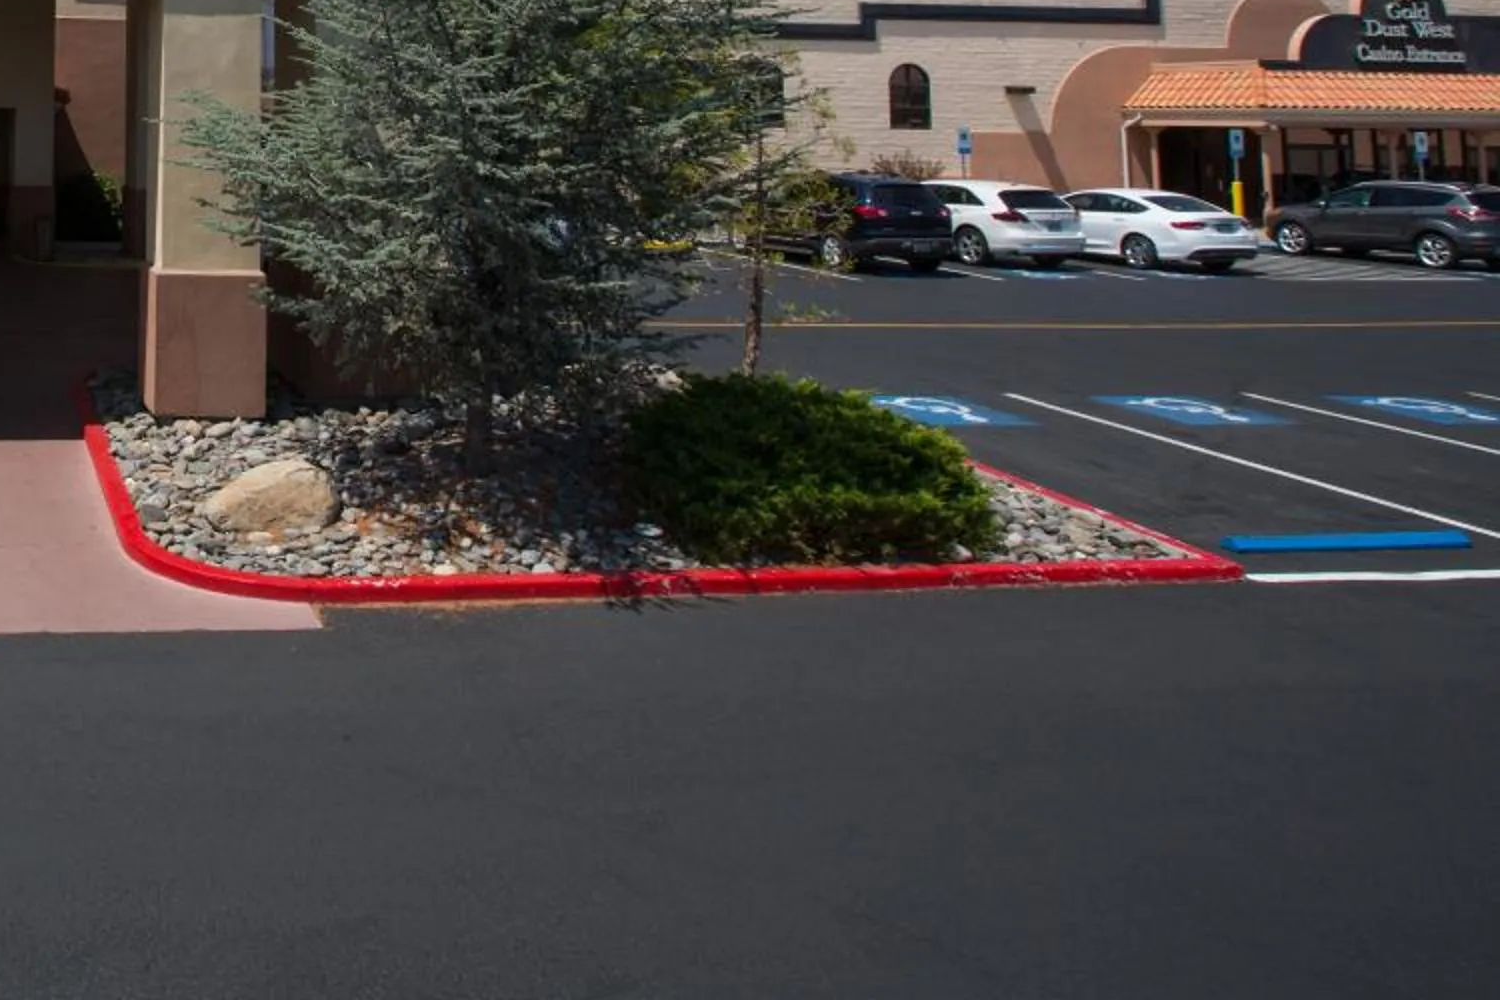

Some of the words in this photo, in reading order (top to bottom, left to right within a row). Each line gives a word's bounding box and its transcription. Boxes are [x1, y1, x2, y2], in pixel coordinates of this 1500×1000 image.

[1386, 2, 1430, 20] Gold
[1364, 19, 1409, 37] Dust
[1411, 21, 1455, 38] West
